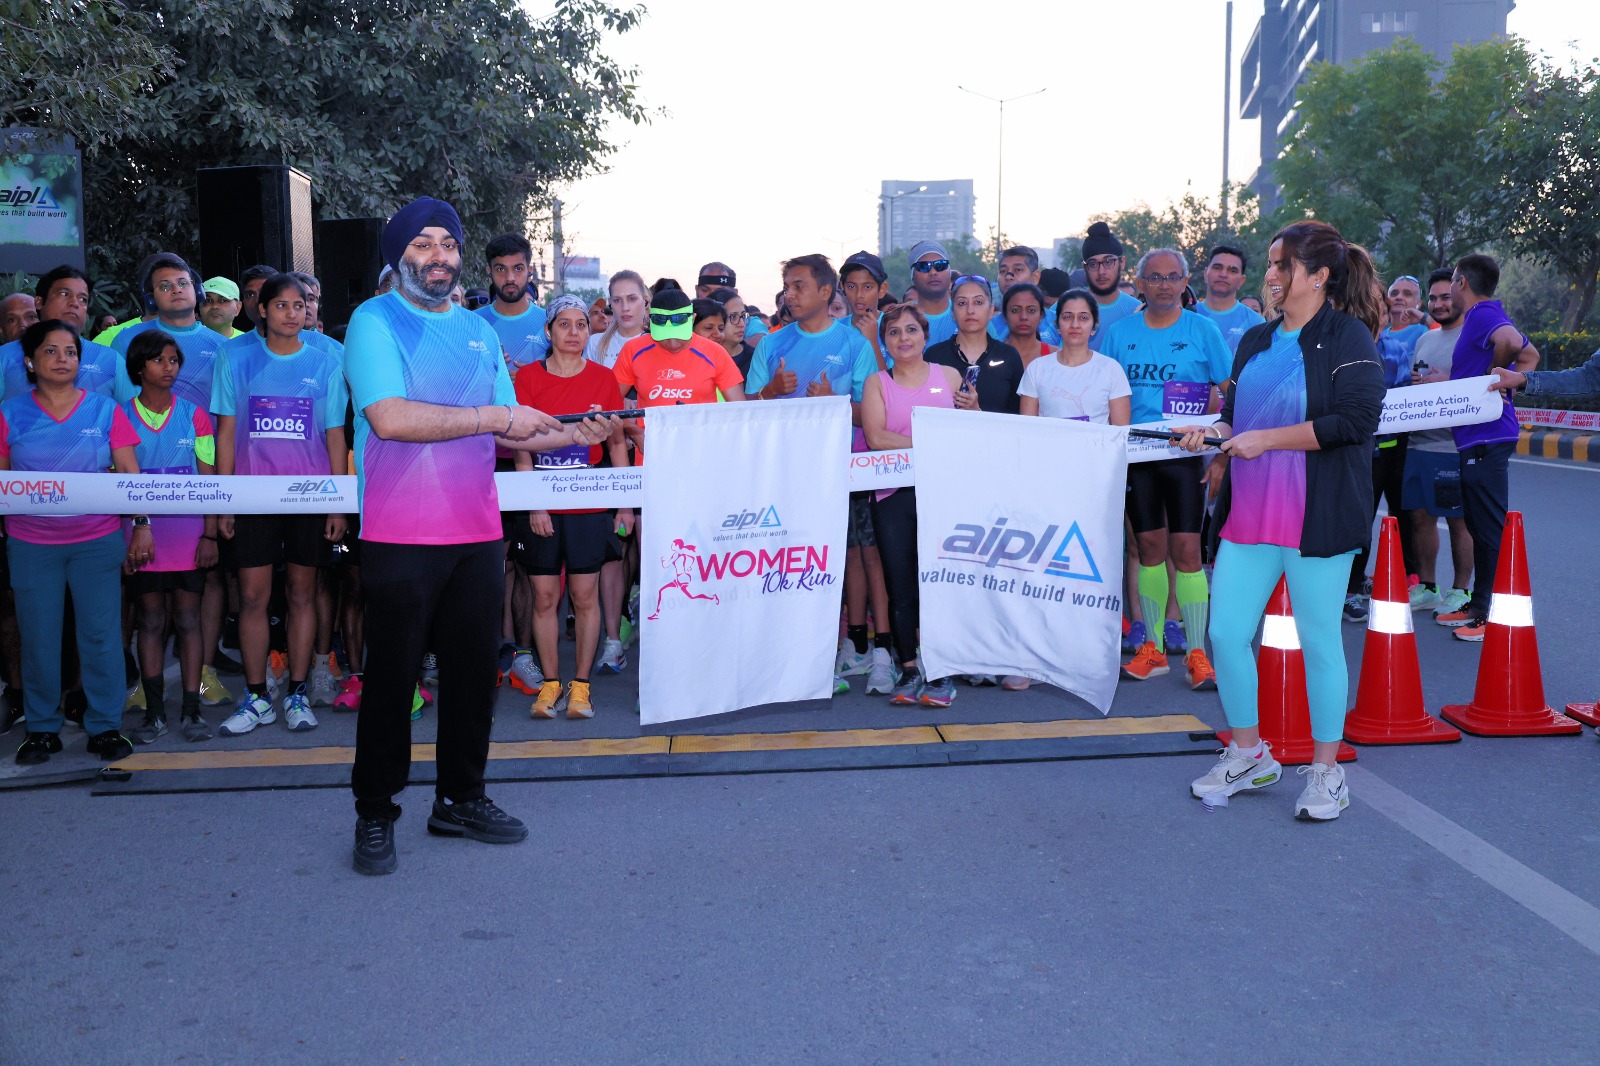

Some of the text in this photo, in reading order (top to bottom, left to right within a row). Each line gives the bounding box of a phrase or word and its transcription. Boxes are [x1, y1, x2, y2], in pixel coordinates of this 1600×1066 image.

[0, 186, 41, 207] aipl
[1127, 363, 1176, 381] BRG
[662, 388, 693, 399] asics
[1170, 400, 1206, 414] 10227
[1381, 394, 1469, 411] Accelerate Action
[1382, 404, 1481, 423] for Gender Equality
[1572, 413, 1595, 421] CAUTION
[254, 417, 305, 432] 10086
[850, 453, 909, 468] OMEN
[875, 460, 914, 476] 10k Run
[117, 479, 220, 489] #Accelerate Action
[541, 472, 642, 482] #Accelerate Action
[287, 479, 326, 495] aipl
[552, 480, 642, 493] for Gender Equal
[28, 490, 69, 505] 10k Run
[127, 489, 232, 503] for Gender Equality
[312, 495, 327, 503] build
[721, 507, 766, 531] aipl
[712, 529, 788, 542] values that build worth
[942, 517, 1060, 568] aipl
[696, 545, 829, 582] WOMEN
[761, 565, 836, 595] 10k Run
[920, 567, 1121, 612] values that build worth
